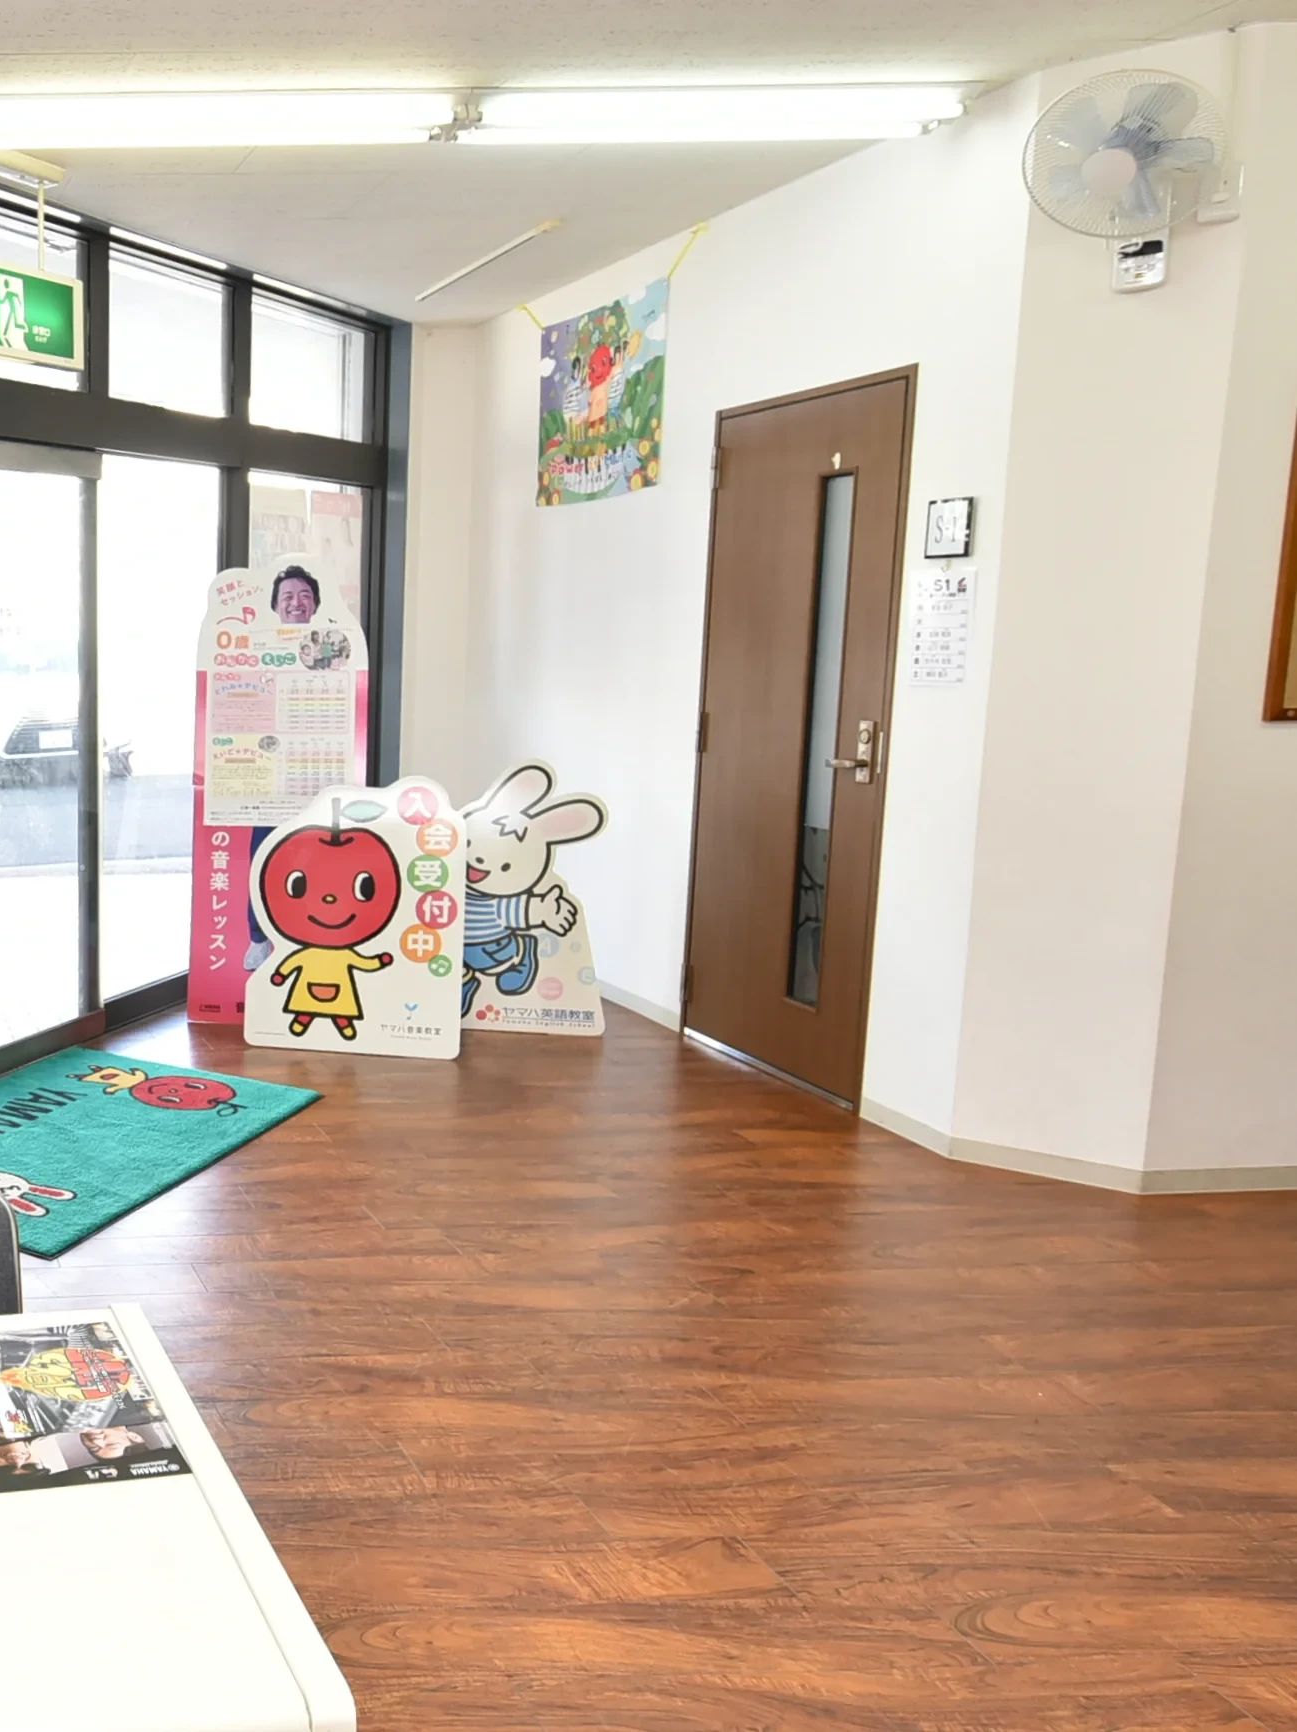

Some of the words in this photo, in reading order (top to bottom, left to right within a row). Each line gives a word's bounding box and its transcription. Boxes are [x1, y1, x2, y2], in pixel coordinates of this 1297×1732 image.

[209, 831, 230, 970] の音楽レッスン
[405, 792, 452, 957] 入会受付中
[502, 1006, 596, 1022] ヤマハ英語教室
[130, 1463, 168, 1477] YAMAHA
